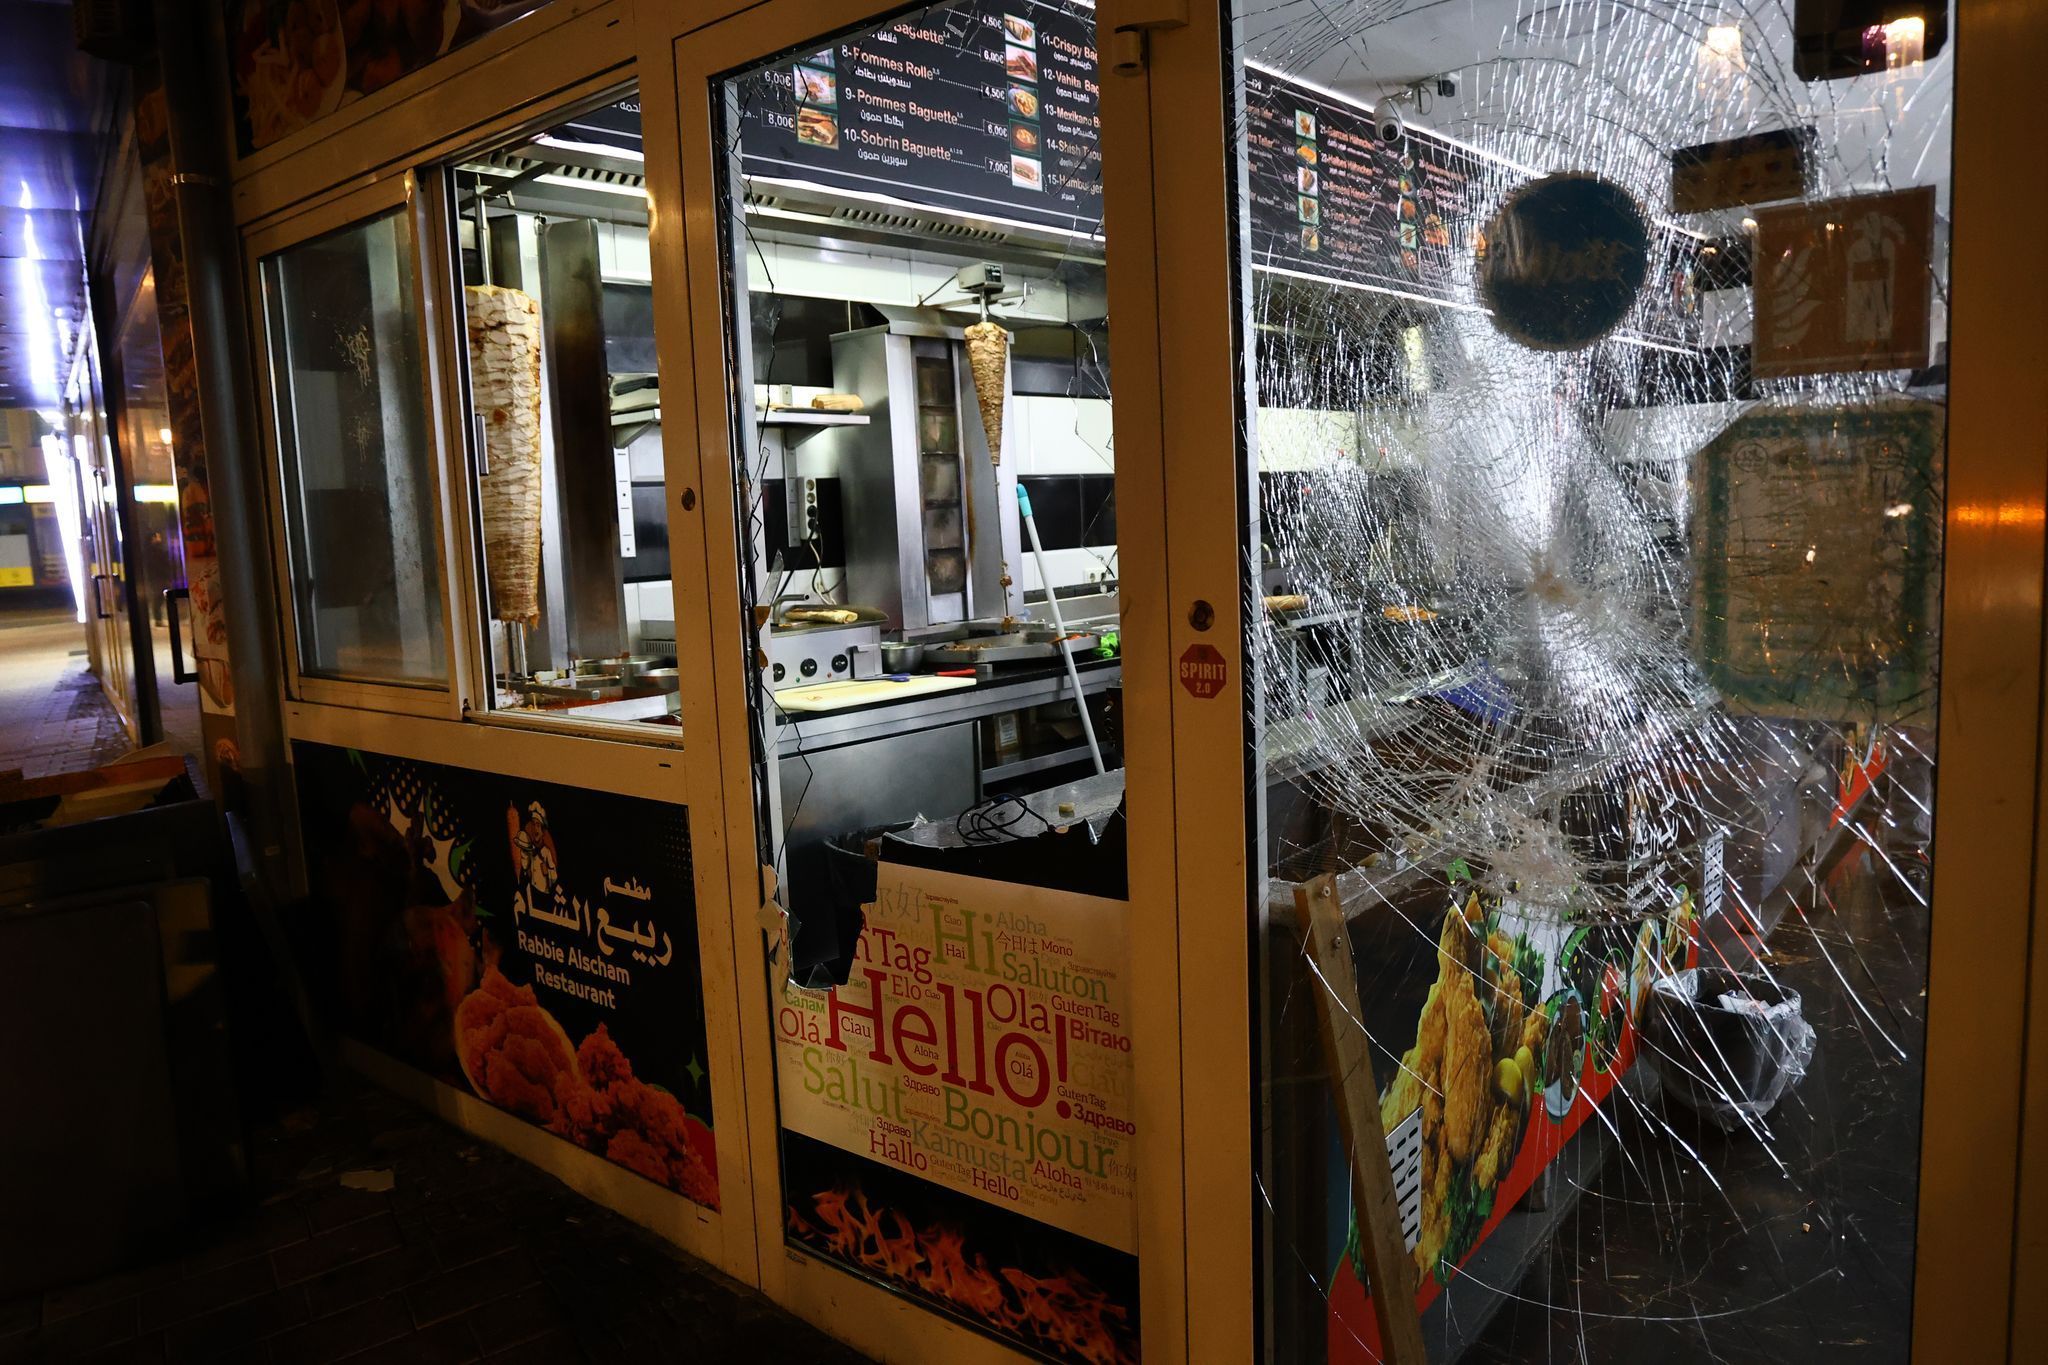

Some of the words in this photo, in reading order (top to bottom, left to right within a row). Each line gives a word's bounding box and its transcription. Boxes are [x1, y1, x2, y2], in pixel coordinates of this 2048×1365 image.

[983, 49, 1005, 65] 6,00€
[905, 60, 934, 80] Rolle
[984, 85, 1006, 100] 4,50€
[767, 112, 795, 130] 8,00€
[908, 100, 958, 125] Baguette
[987, 124, 1008, 138] 6,00€
[901, 139, 951, 161] Baguette
[988, 160, 1009, 175] 7,00€
[1180, 661, 1225, 681] SPIRIT
[1195, 681, 1212, 694] 2.0
[603, 875, 652, 901] مطعم
[513, 882, 592, 937] الشام
[943, 913, 963, 927] Ciao
[995, 910, 1048, 936] Aloha
[596, 907, 674, 968] ربيع
[928, 902, 1000, 977] Hi
[996, 930, 1039, 955] 今日は
[1040, 938, 1073, 957] Mono
[517, 929, 565, 964] Rabbie
[567, 946, 632, 986] Alscham
[945, 943, 966, 960] Hai
[534, 962, 617, 1010] Restaurant
[891, 974, 922, 1001] Elo
[1002, 951, 1109, 1004] Saluton
[924, 988, 941, 1000] Ciao
[987, 983, 1052, 1035] Ola
[779, 1006, 823, 1046] Olá
[840, 1015, 873, 1040] Ciau
[1069, 1017, 1133, 1054] Вітаю
[913, 1043, 940, 1061] Aloha
[1010, 1059, 1035, 1080] Olá
[802, 1045, 909, 1125] Salut
[902, 1074, 942, 1098] Здраво
[876, 1115, 913, 1139] Здраво
[942, 1083, 1115, 1180] Bonjour
[1073, 1102, 1137, 1136] Здраво
[868, 1128, 928, 1172] Hallo
[910, 1117, 1028, 1184] Kamusta
[971, 1167, 1020, 1202] Hello
[1032, 1159, 1083, 1190] Aloha
